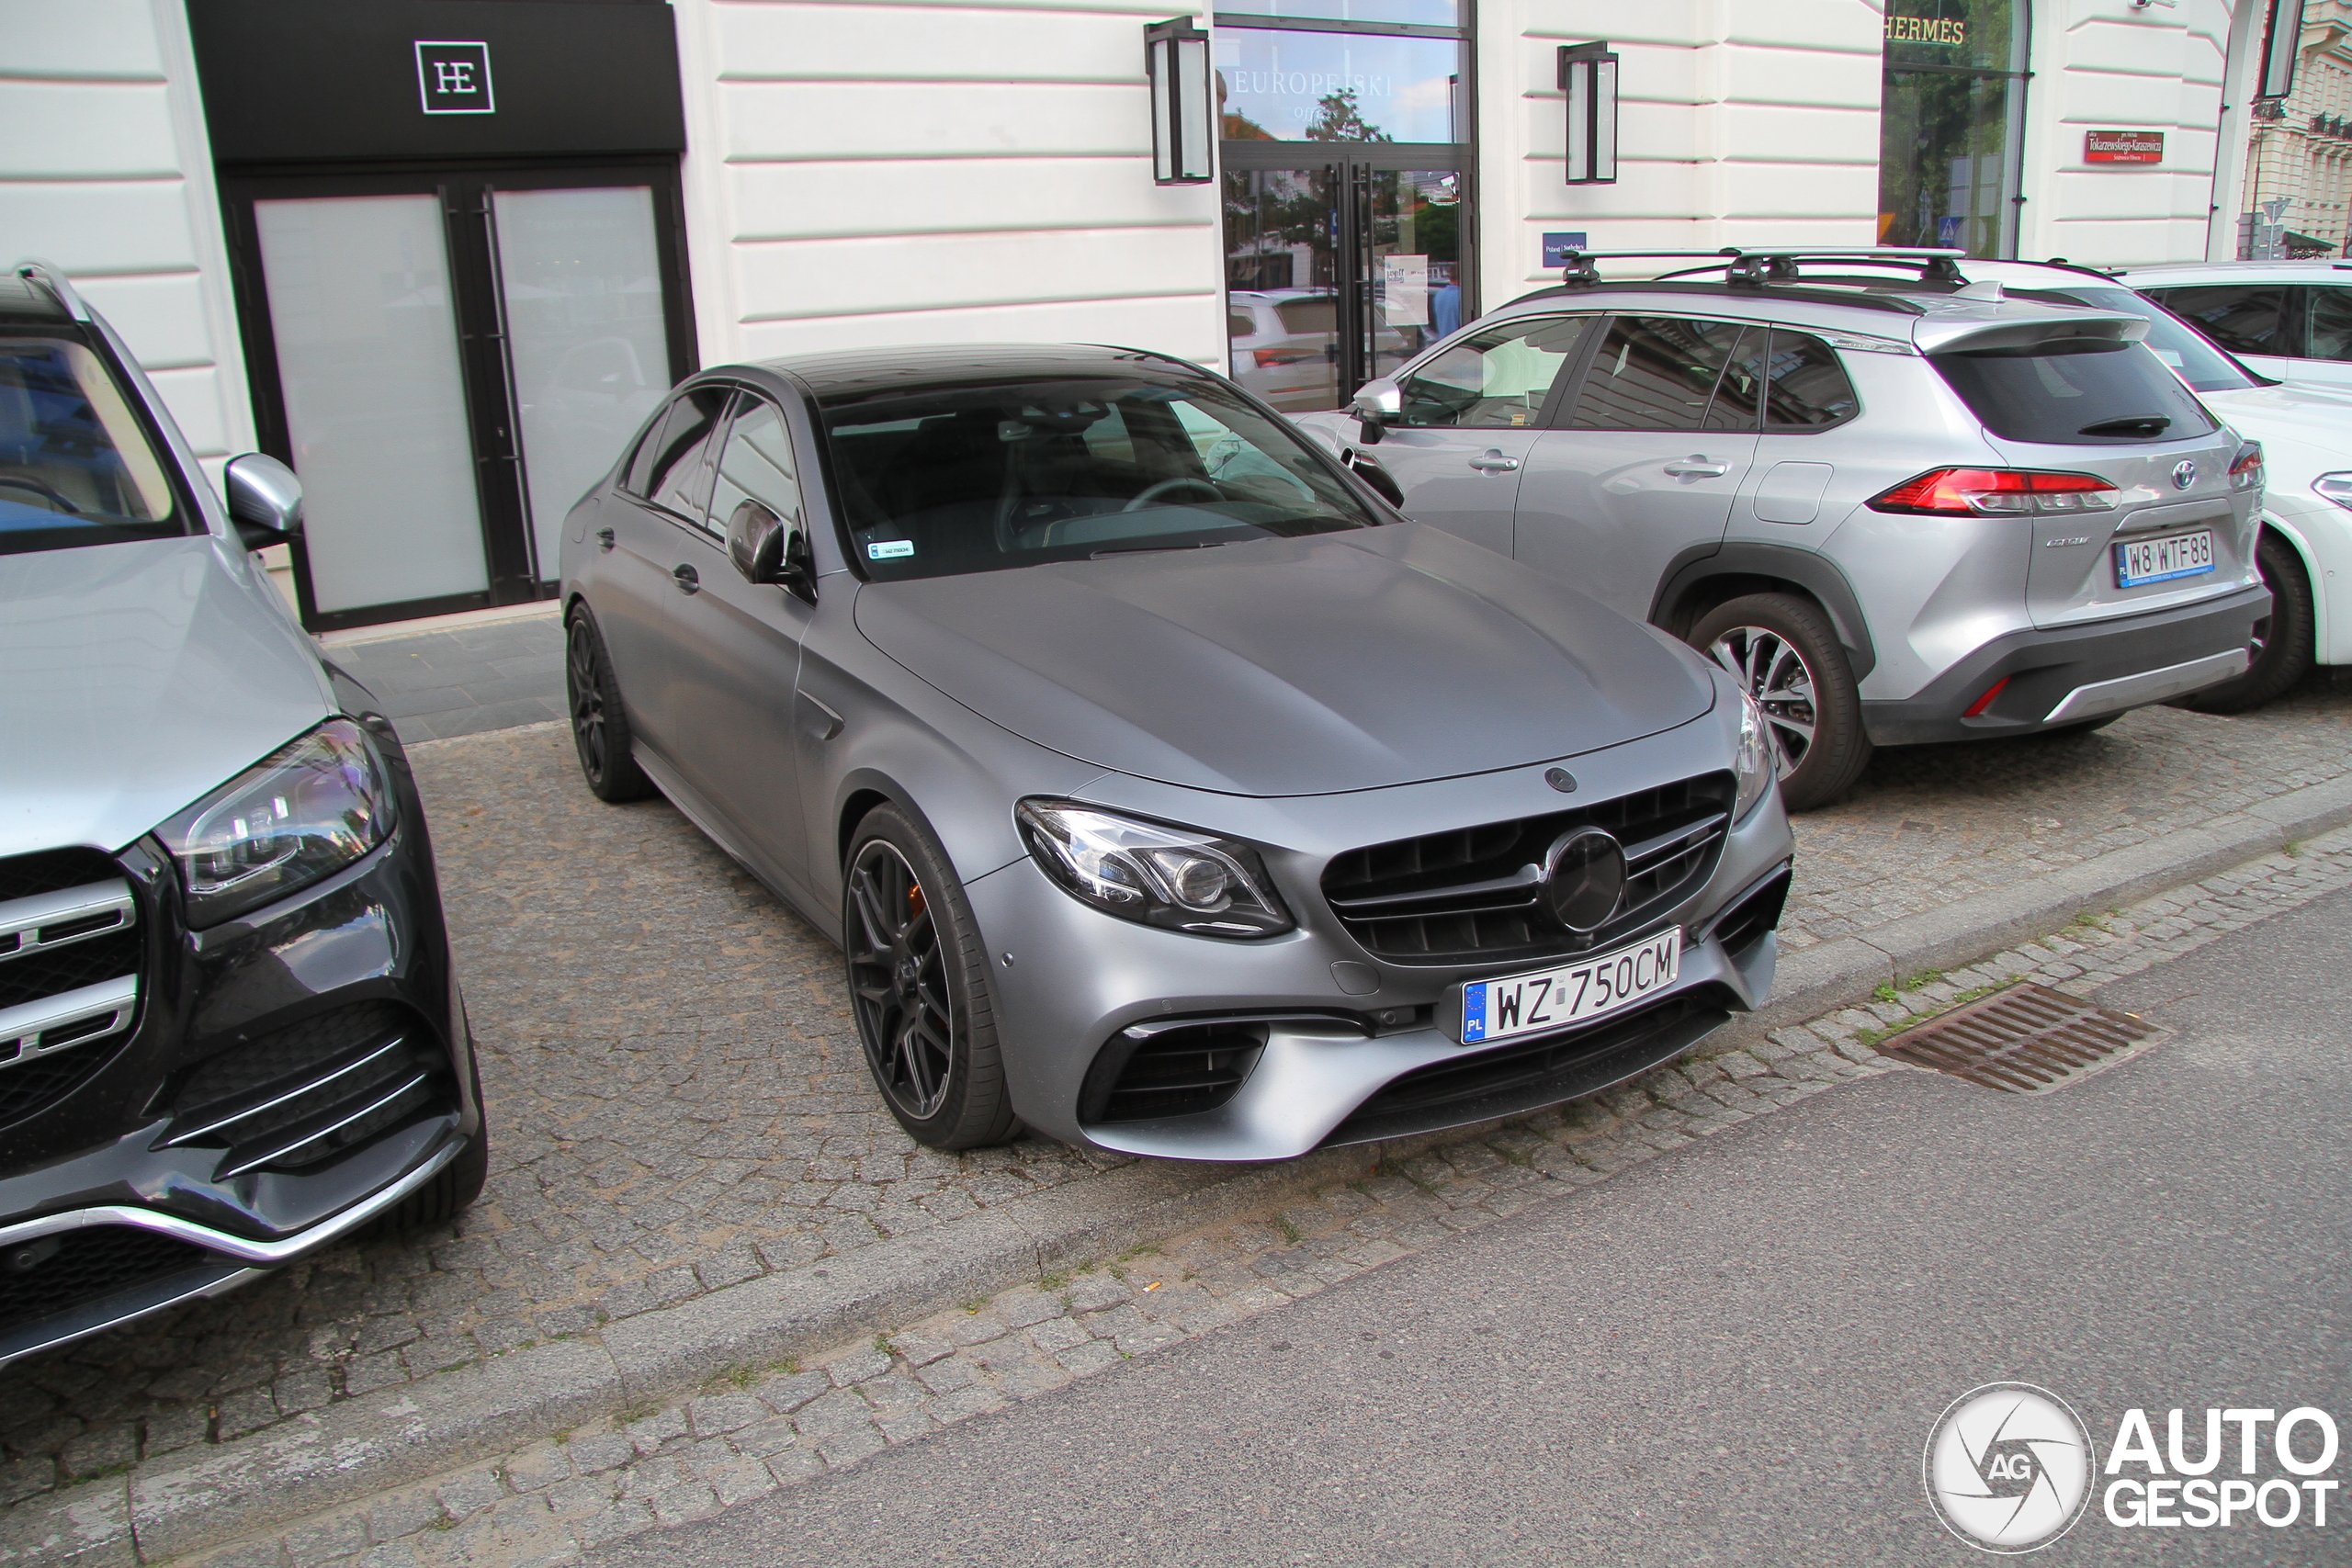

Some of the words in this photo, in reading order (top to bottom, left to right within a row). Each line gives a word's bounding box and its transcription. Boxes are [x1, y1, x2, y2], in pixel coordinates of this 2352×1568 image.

[434, 62, 477, 94] HE
[1234, 70, 1392, 97] EUROPEJSKI
[2129, 545, 2152, 576] W8
[2158, 535, 2210, 571] WTF88
[1497, 977, 1553, 1030] WZ
[1569, 937, 1672, 1016] 750CM
[1466, 1020, 1483, 1032] PL
